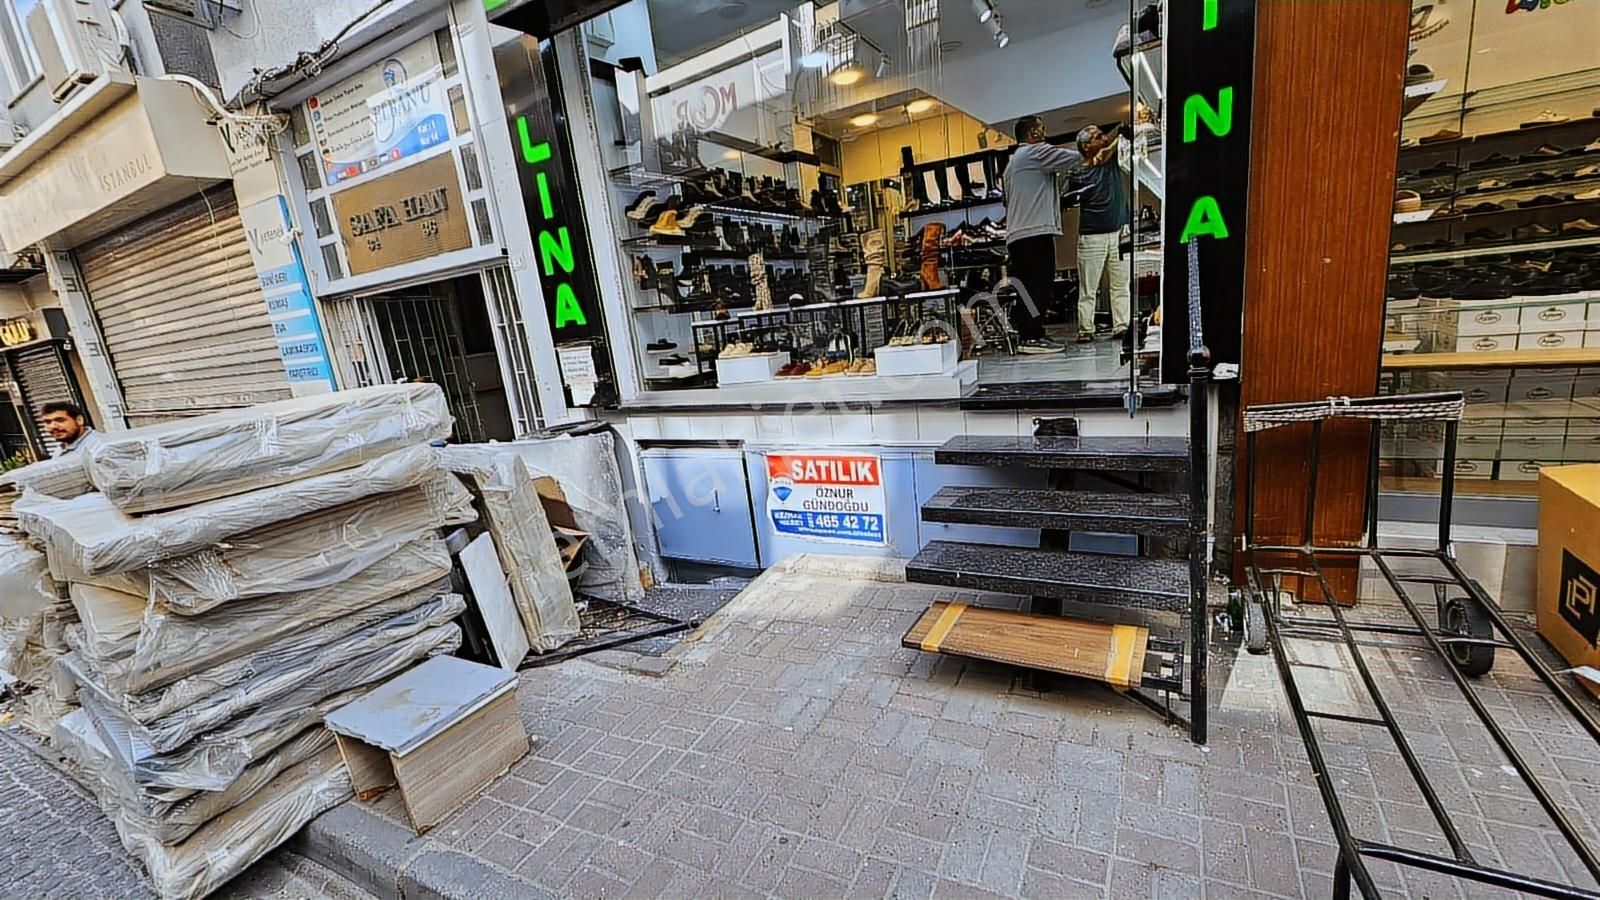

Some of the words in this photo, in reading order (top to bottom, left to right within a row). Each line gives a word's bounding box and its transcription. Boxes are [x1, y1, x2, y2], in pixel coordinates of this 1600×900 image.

[350, 205, 402, 237] SAFA
[400, 186, 449, 221] HAN
[516, 115, 587, 329] LINA
[791, 459, 875, 483] SATILIK
[815, 484, 854, 499] ÖZNUR
[802, 498, 870, 512] GÜNDOĞDU
[815, 513, 840, 529] 465
[843, 515, 860, 529] 42
[862, 516, 880, 531] 72
